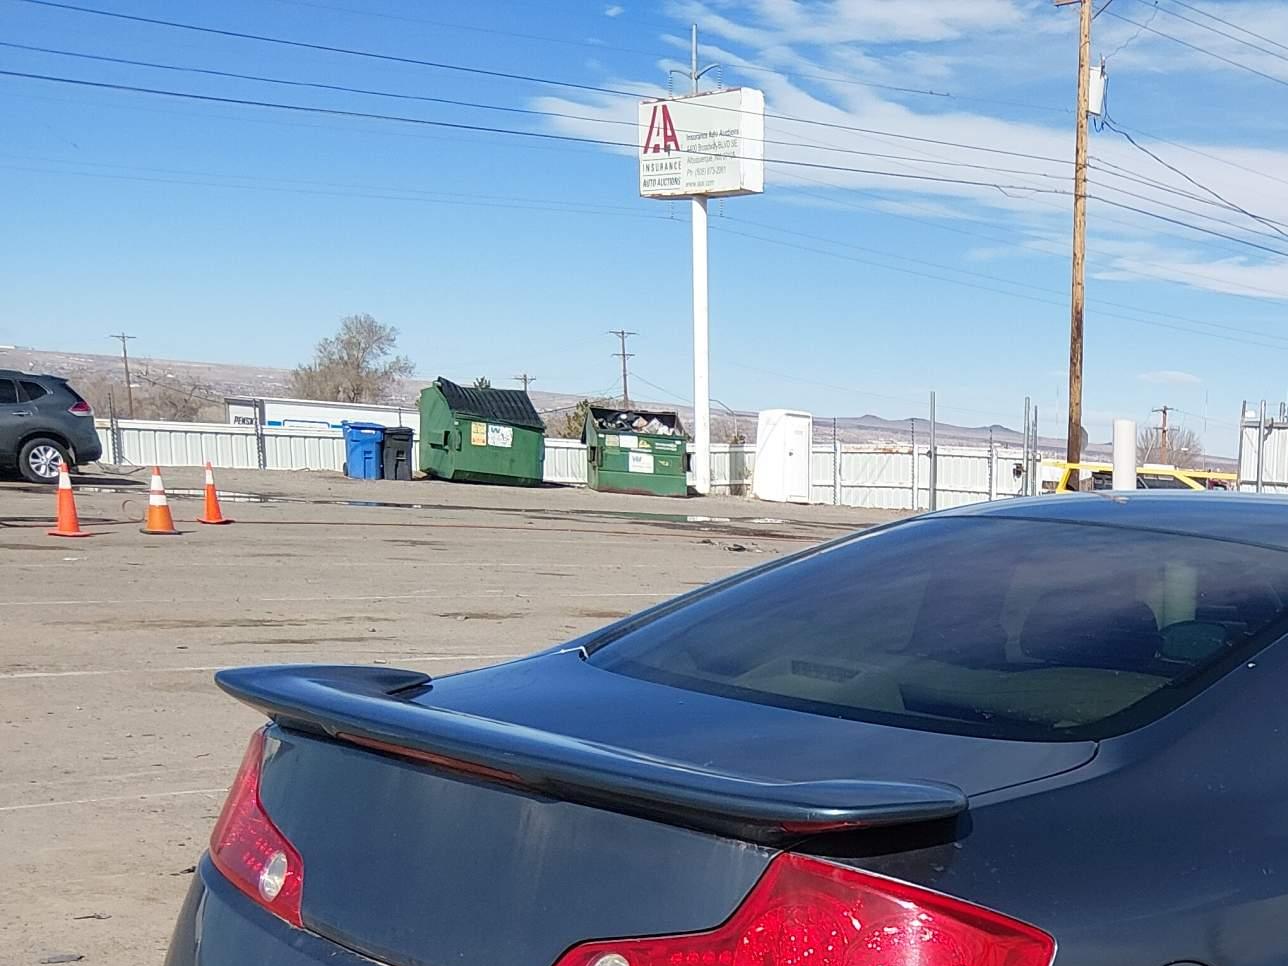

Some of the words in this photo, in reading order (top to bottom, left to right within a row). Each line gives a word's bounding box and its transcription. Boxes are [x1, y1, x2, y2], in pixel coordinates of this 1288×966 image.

[642, 160, 682, 173] INSURANCE
[643, 178, 657, 188] AUTO
[657, 176, 681, 187] AUCTIONS
